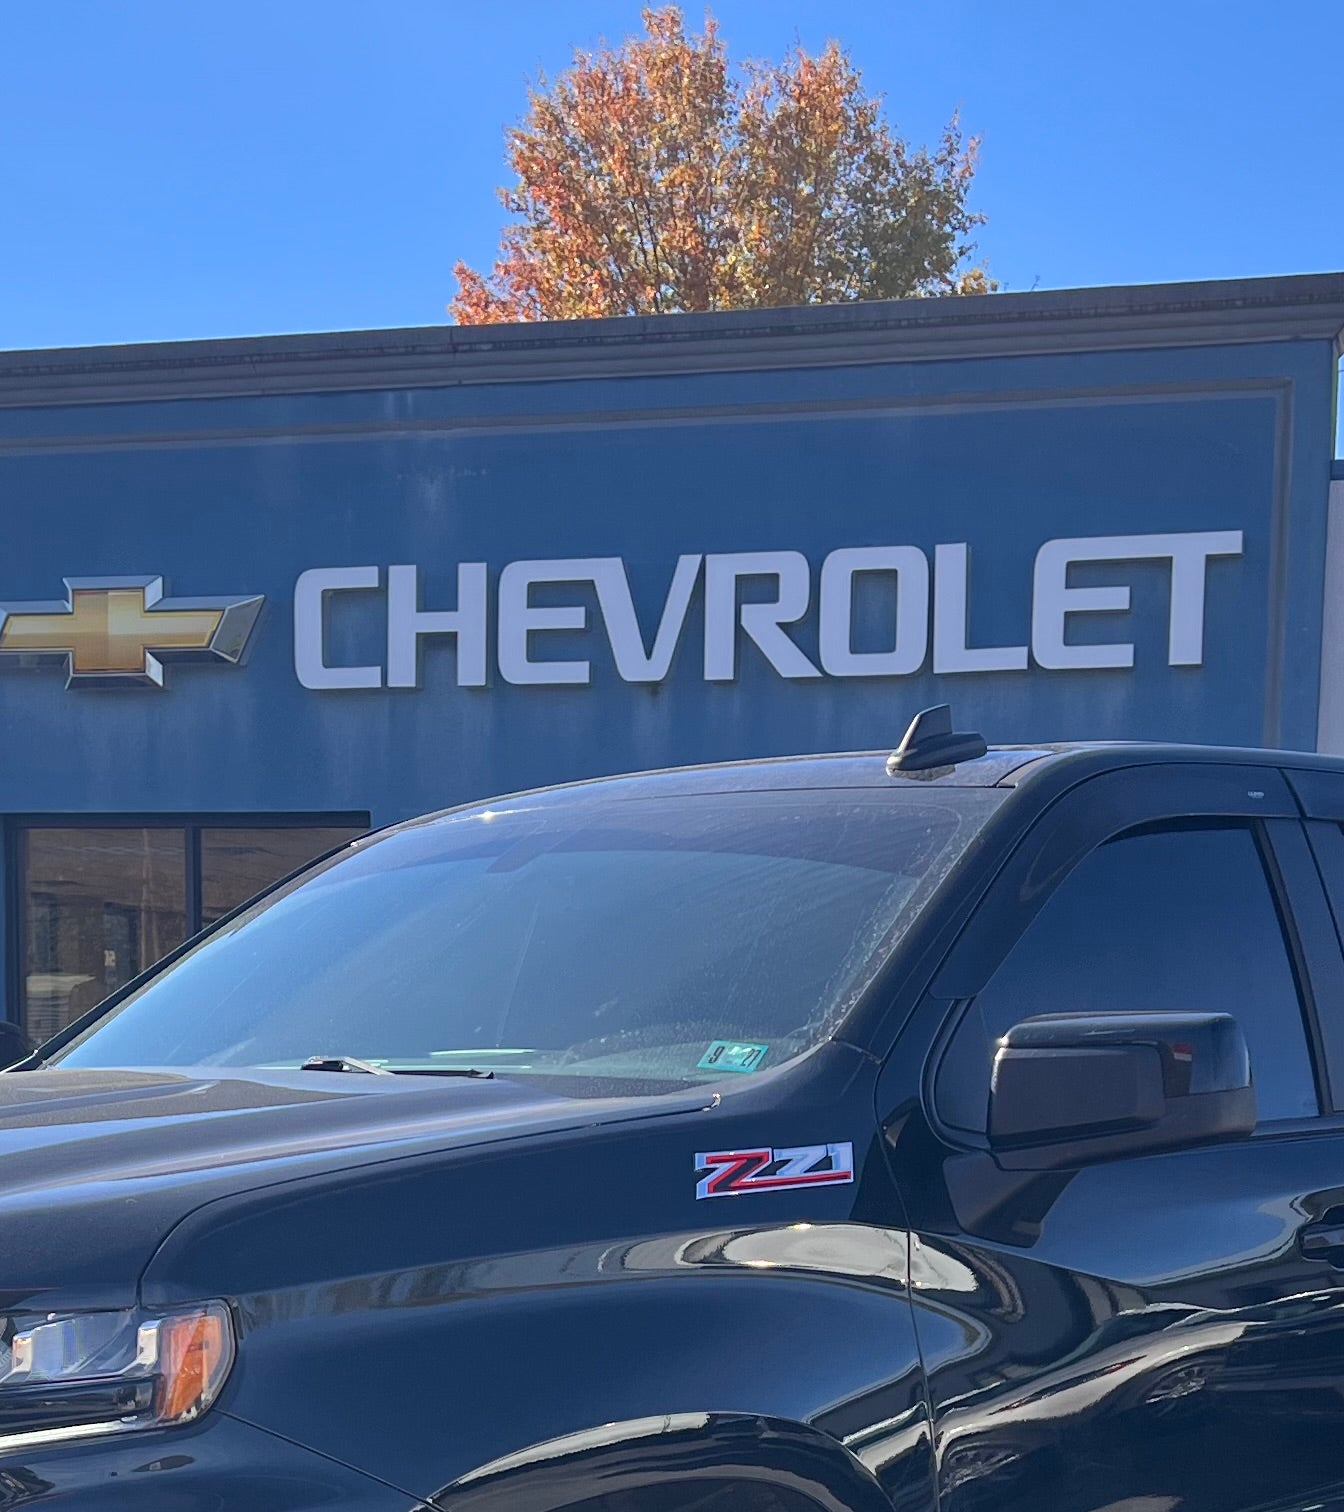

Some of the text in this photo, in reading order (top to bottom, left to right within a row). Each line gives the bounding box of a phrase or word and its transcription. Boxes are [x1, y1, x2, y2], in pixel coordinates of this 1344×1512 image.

[294, 530, 1244, 690] CHEVROLET
[707, 1045, 725, 1064] 9
[694, 1141, 855, 1200] Z71
